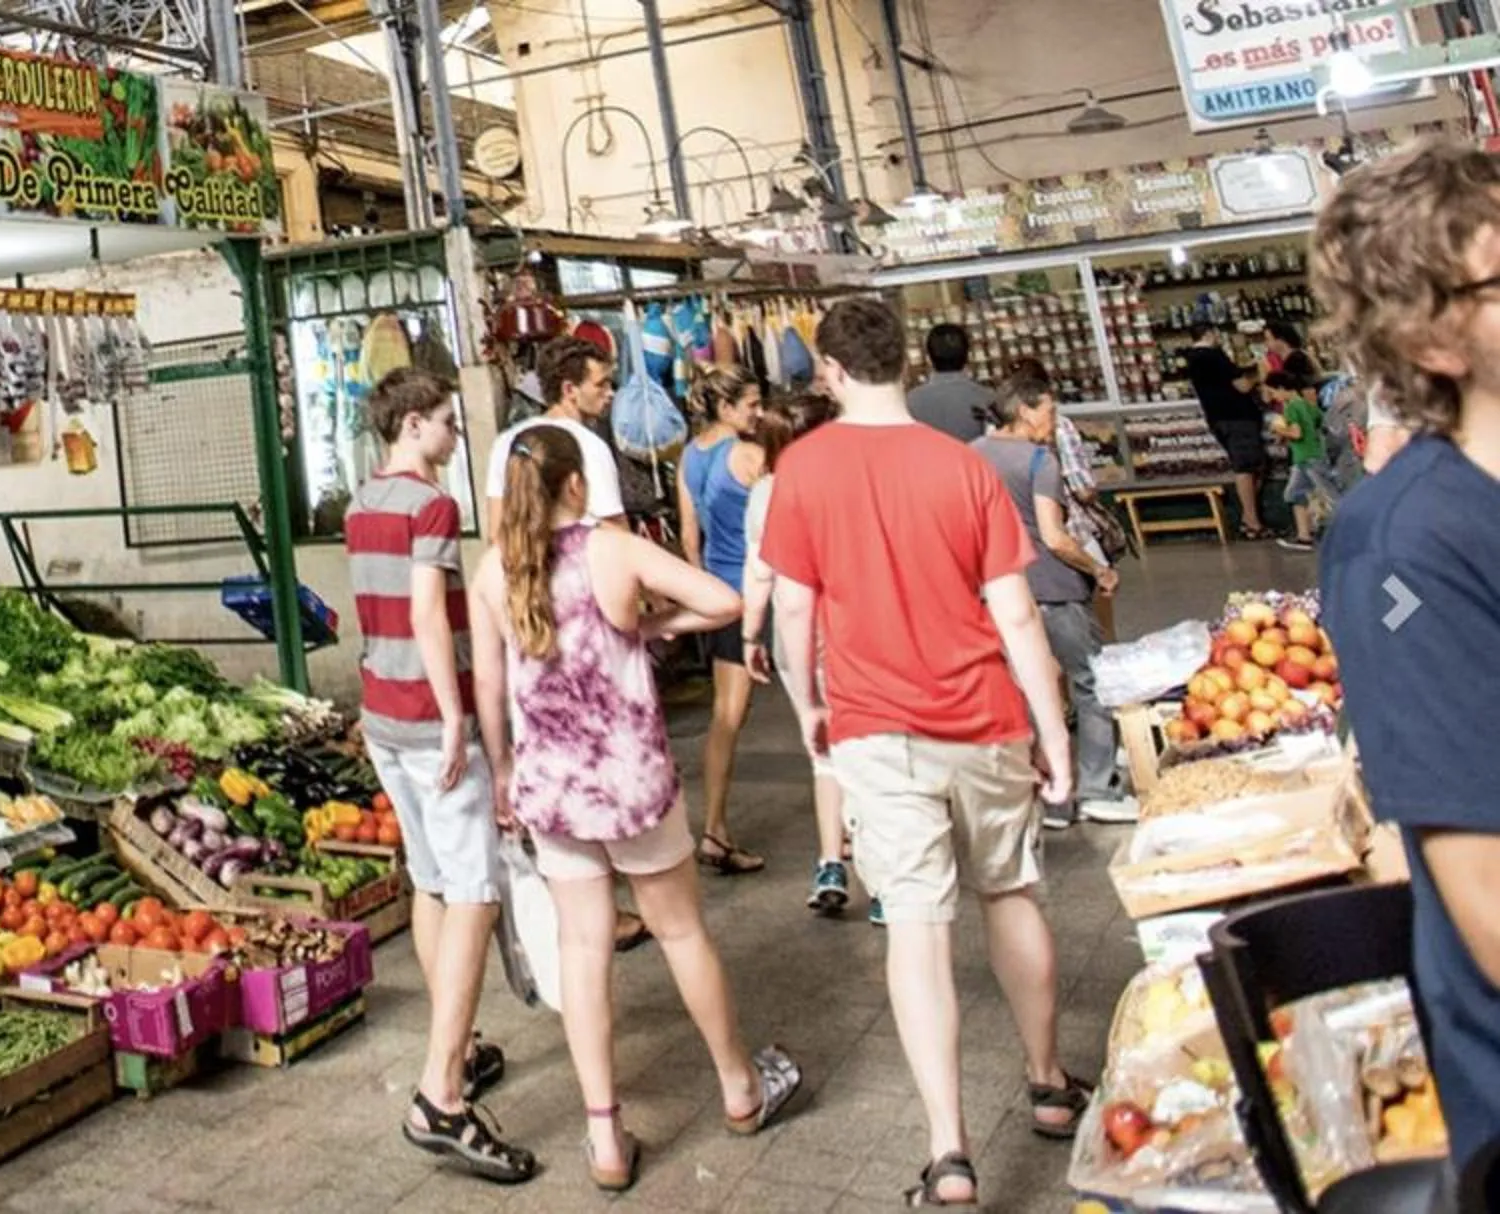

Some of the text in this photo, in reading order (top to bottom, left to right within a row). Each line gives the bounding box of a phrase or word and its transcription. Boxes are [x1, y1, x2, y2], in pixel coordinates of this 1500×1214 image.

[1242, 37, 1301, 68] más
[1204, 78, 1317, 114] AMITRANO
[49, 154, 159, 210] Primera
[165, 166, 262, 218] Calidad
